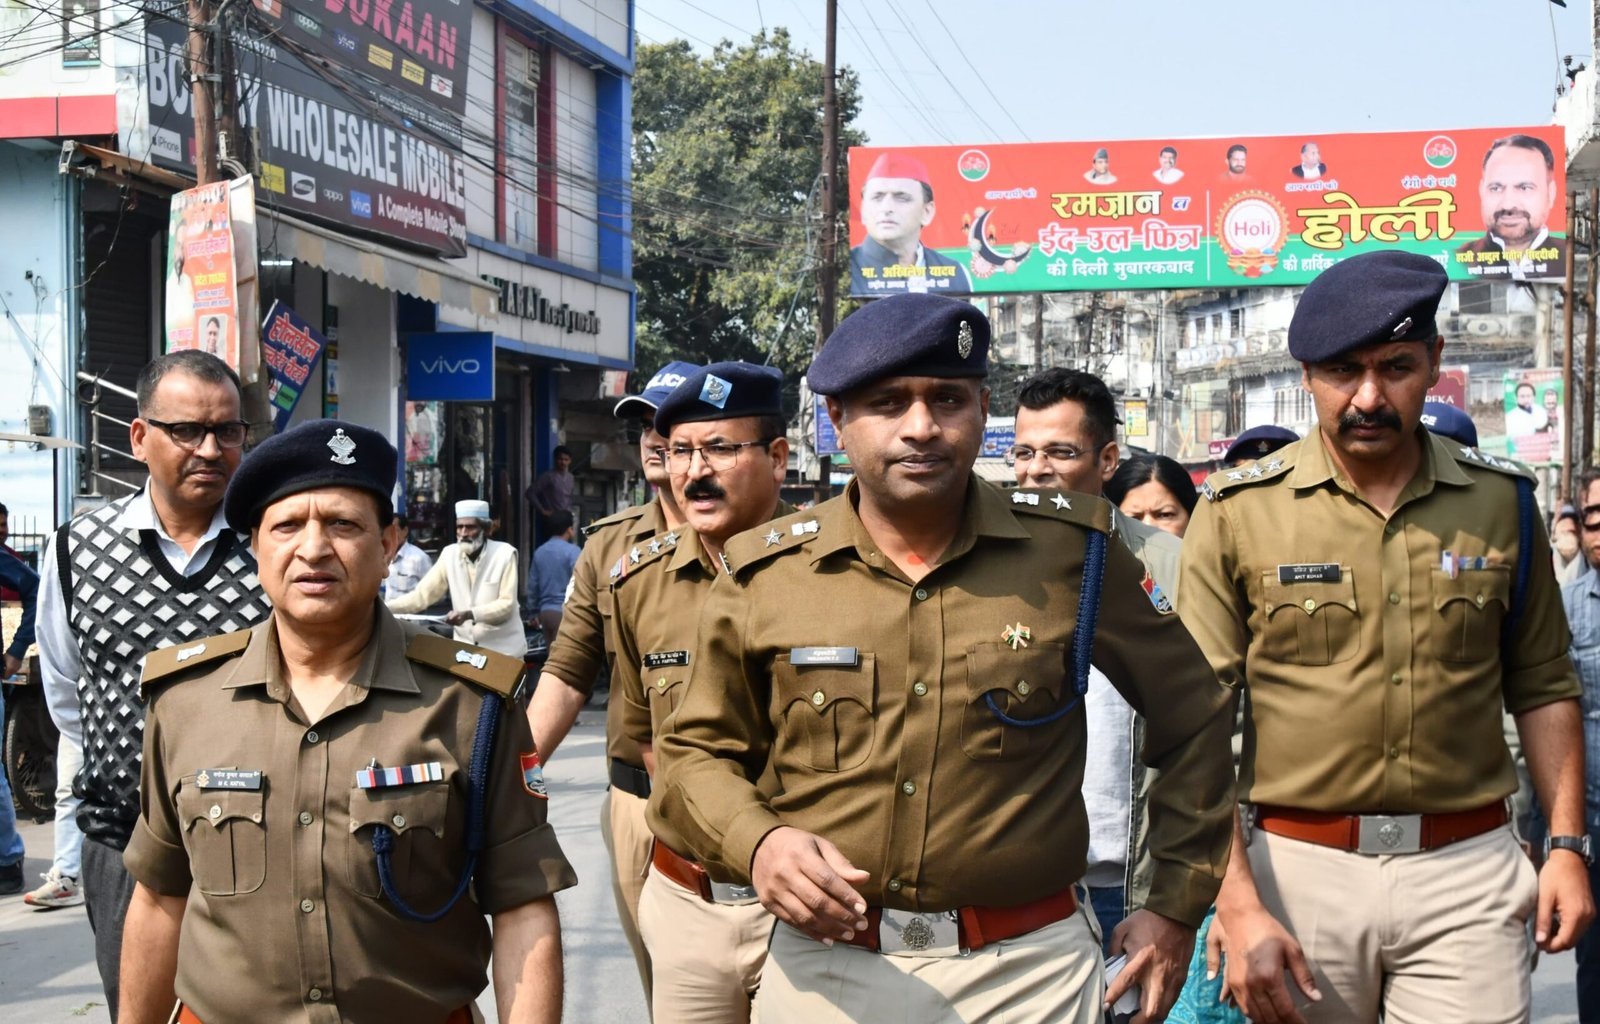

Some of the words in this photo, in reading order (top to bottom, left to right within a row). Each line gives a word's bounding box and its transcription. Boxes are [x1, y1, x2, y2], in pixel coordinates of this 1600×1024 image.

[325, 0, 457, 70] UKAAN
[157, 134, 180, 153] iPhone
[267, 82, 399, 187] WHOLESALE
[401, 135, 466, 209] MOBILE
[323, 188, 344, 202] oppo
[351, 196, 371, 214] vivo
[1051, 190, 1163, 219] रमज़ान
[378, 193, 386, 217] A
[386, 195, 423, 229] Complete
[424, 208, 449, 235] Mobile
[1297, 189, 1457, 250] होली
[1234, 221, 1271, 237] Holi
[1047, 258, 1067, 276] की
[1072, 257, 1109, 277] दिली
[1113, 260, 1194, 280] मुबारकबाद
[1283, 254, 1298, 272] की
[419, 355, 481, 374] vivo
